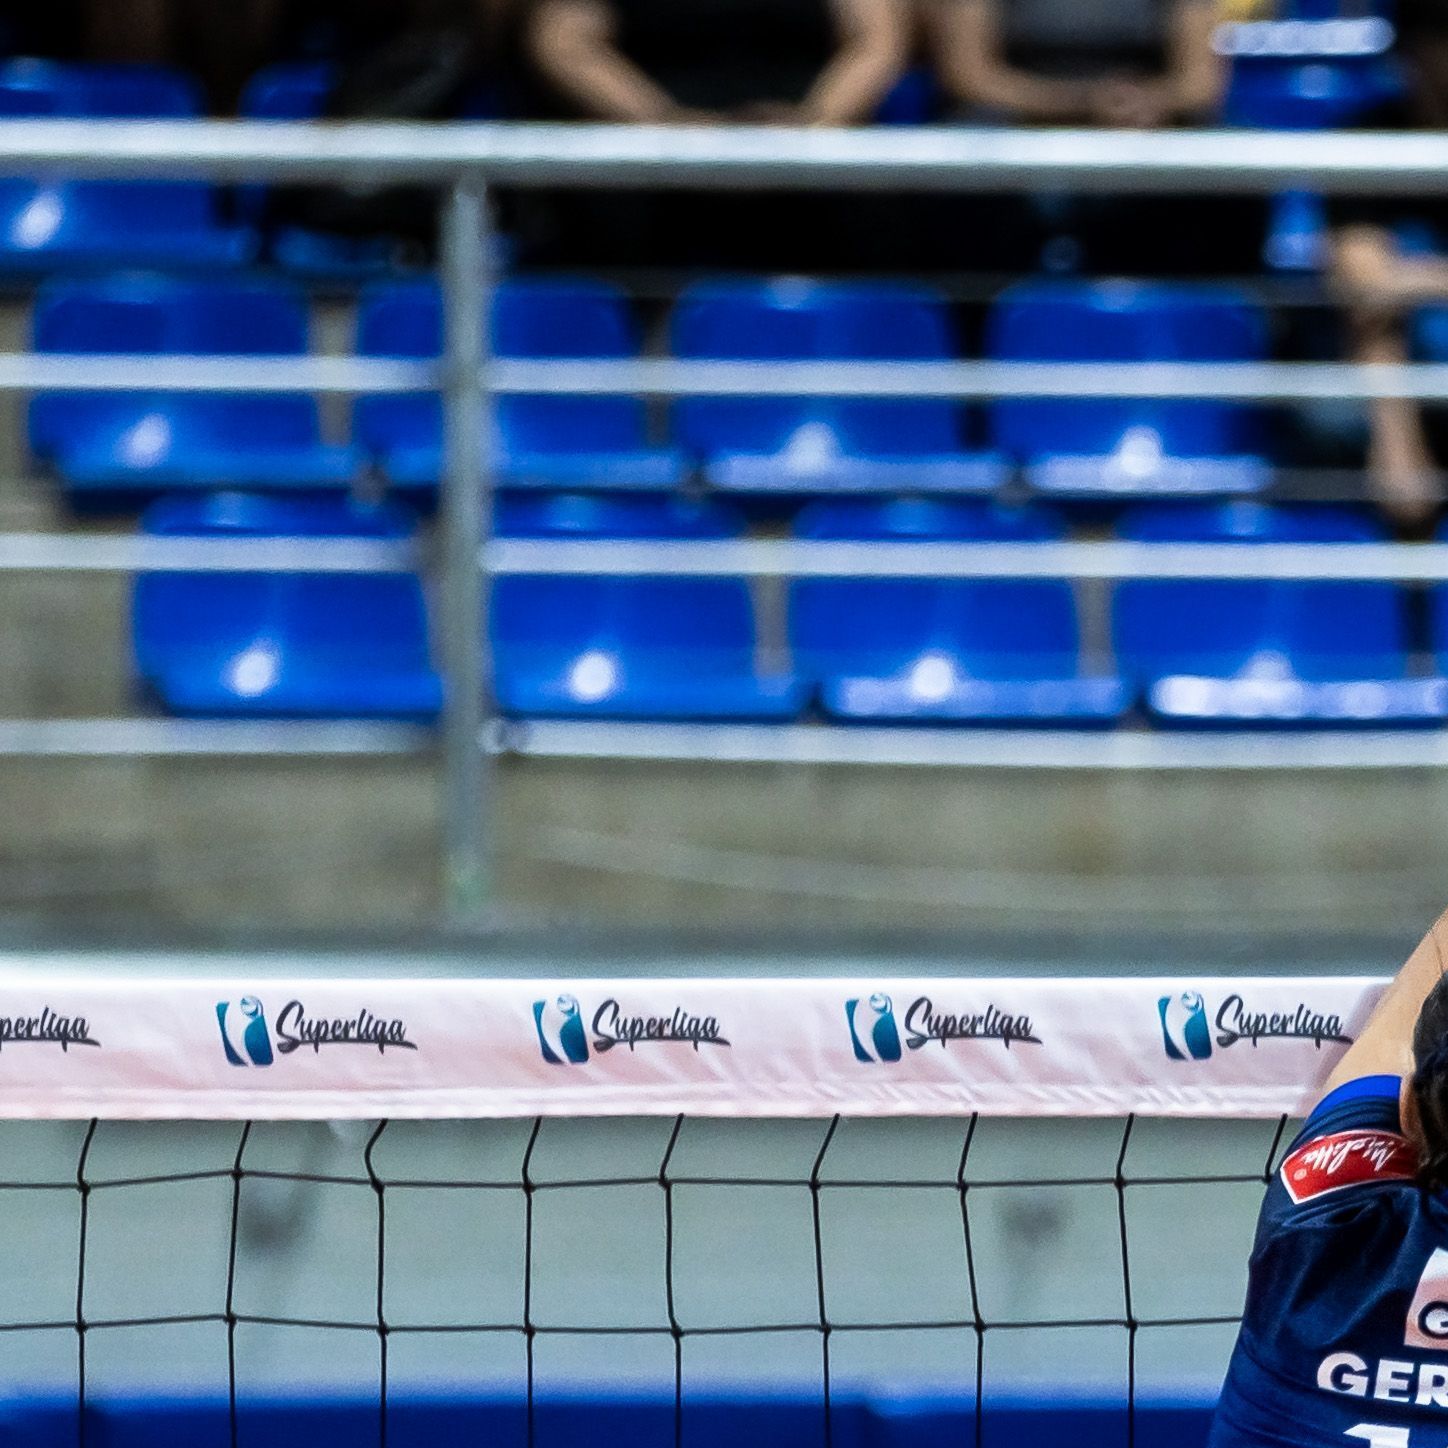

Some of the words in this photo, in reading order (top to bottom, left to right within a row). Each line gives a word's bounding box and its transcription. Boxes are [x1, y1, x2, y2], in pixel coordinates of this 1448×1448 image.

[0, 1005, 101, 1053] perliga
[275, 1000, 418, 1053] Superliga
[592, 999, 731, 1053] Superliga
[904, 997, 1043, 1050] Superliga
[1215, 995, 1355, 1049] Superliga
